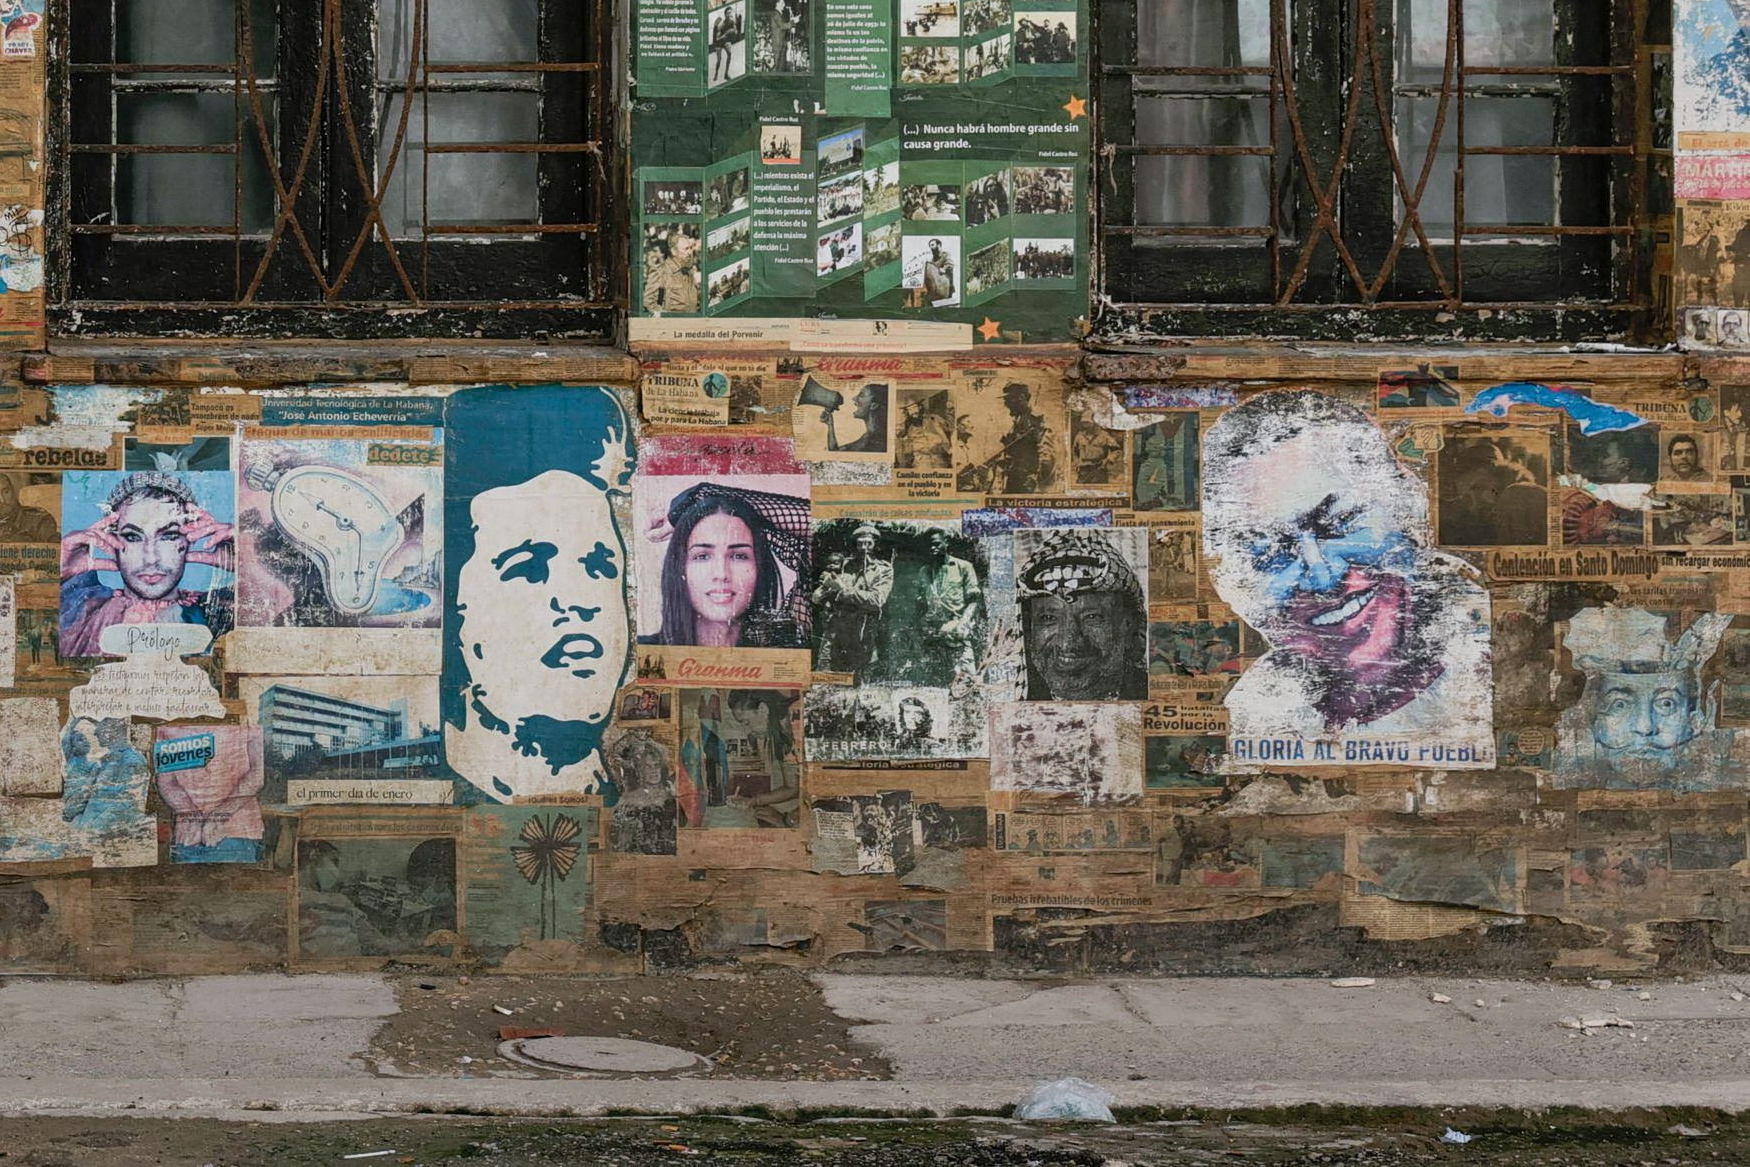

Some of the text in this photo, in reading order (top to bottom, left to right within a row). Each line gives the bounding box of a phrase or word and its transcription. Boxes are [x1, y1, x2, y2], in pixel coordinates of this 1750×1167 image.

[923, 124, 954, 133] Nunca
[957, 123, 984, 133] habrá
[987, 123, 1024, 133] hombre
[1028, 125, 1061, 135] grande
[1065, 123, 1078, 132] sin
[904, 140, 971, 150] causa grande.
[674, 329, 763, 338] La medalla del Porvenir
[370, 448, 429, 464] dedete
[1493, 553, 1658, 579] Contención en Santo Domingo
[127, 628, 181, 661] Prólogo
[677, 659, 763, 679] Granma
[161, 739, 210, 753] somos
[1233, 738, 1305, 761] GLORIA
[1313, 740, 1338, 762] AL
[156, 748, 212, 767] jóvenes
[297, 788, 305, 800] el
[308, 788, 345, 803] primer
[367, 788, 378, 799] de
[381, 789, 412, 800] enero
